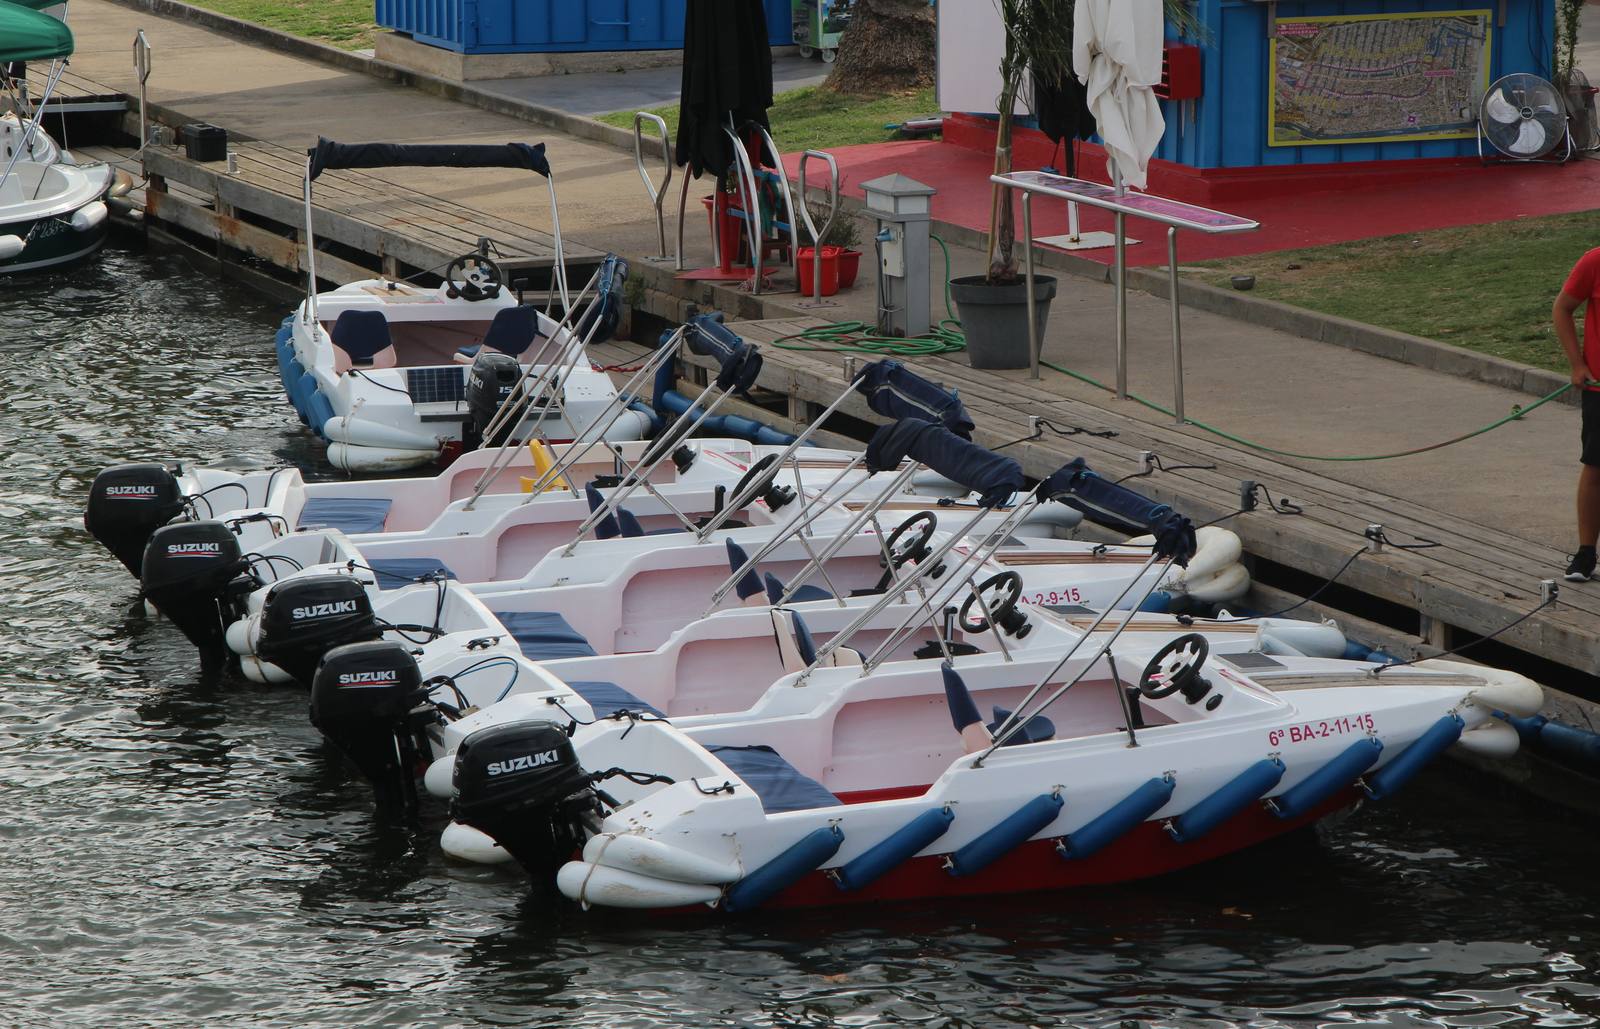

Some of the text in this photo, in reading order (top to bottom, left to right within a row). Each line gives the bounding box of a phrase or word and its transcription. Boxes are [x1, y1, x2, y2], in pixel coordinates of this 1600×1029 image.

[106, 486, 155, 495] SUZUKI
[168, 543, 220, 553] SUZUKI
[292, 600, 357, 619] SUZUKI
[339, 670, 396, 684] SUZUKI
[1289, 714, 1374, 743] BA-2-11-15
[487, 749, 559, 776] SUZUKI
